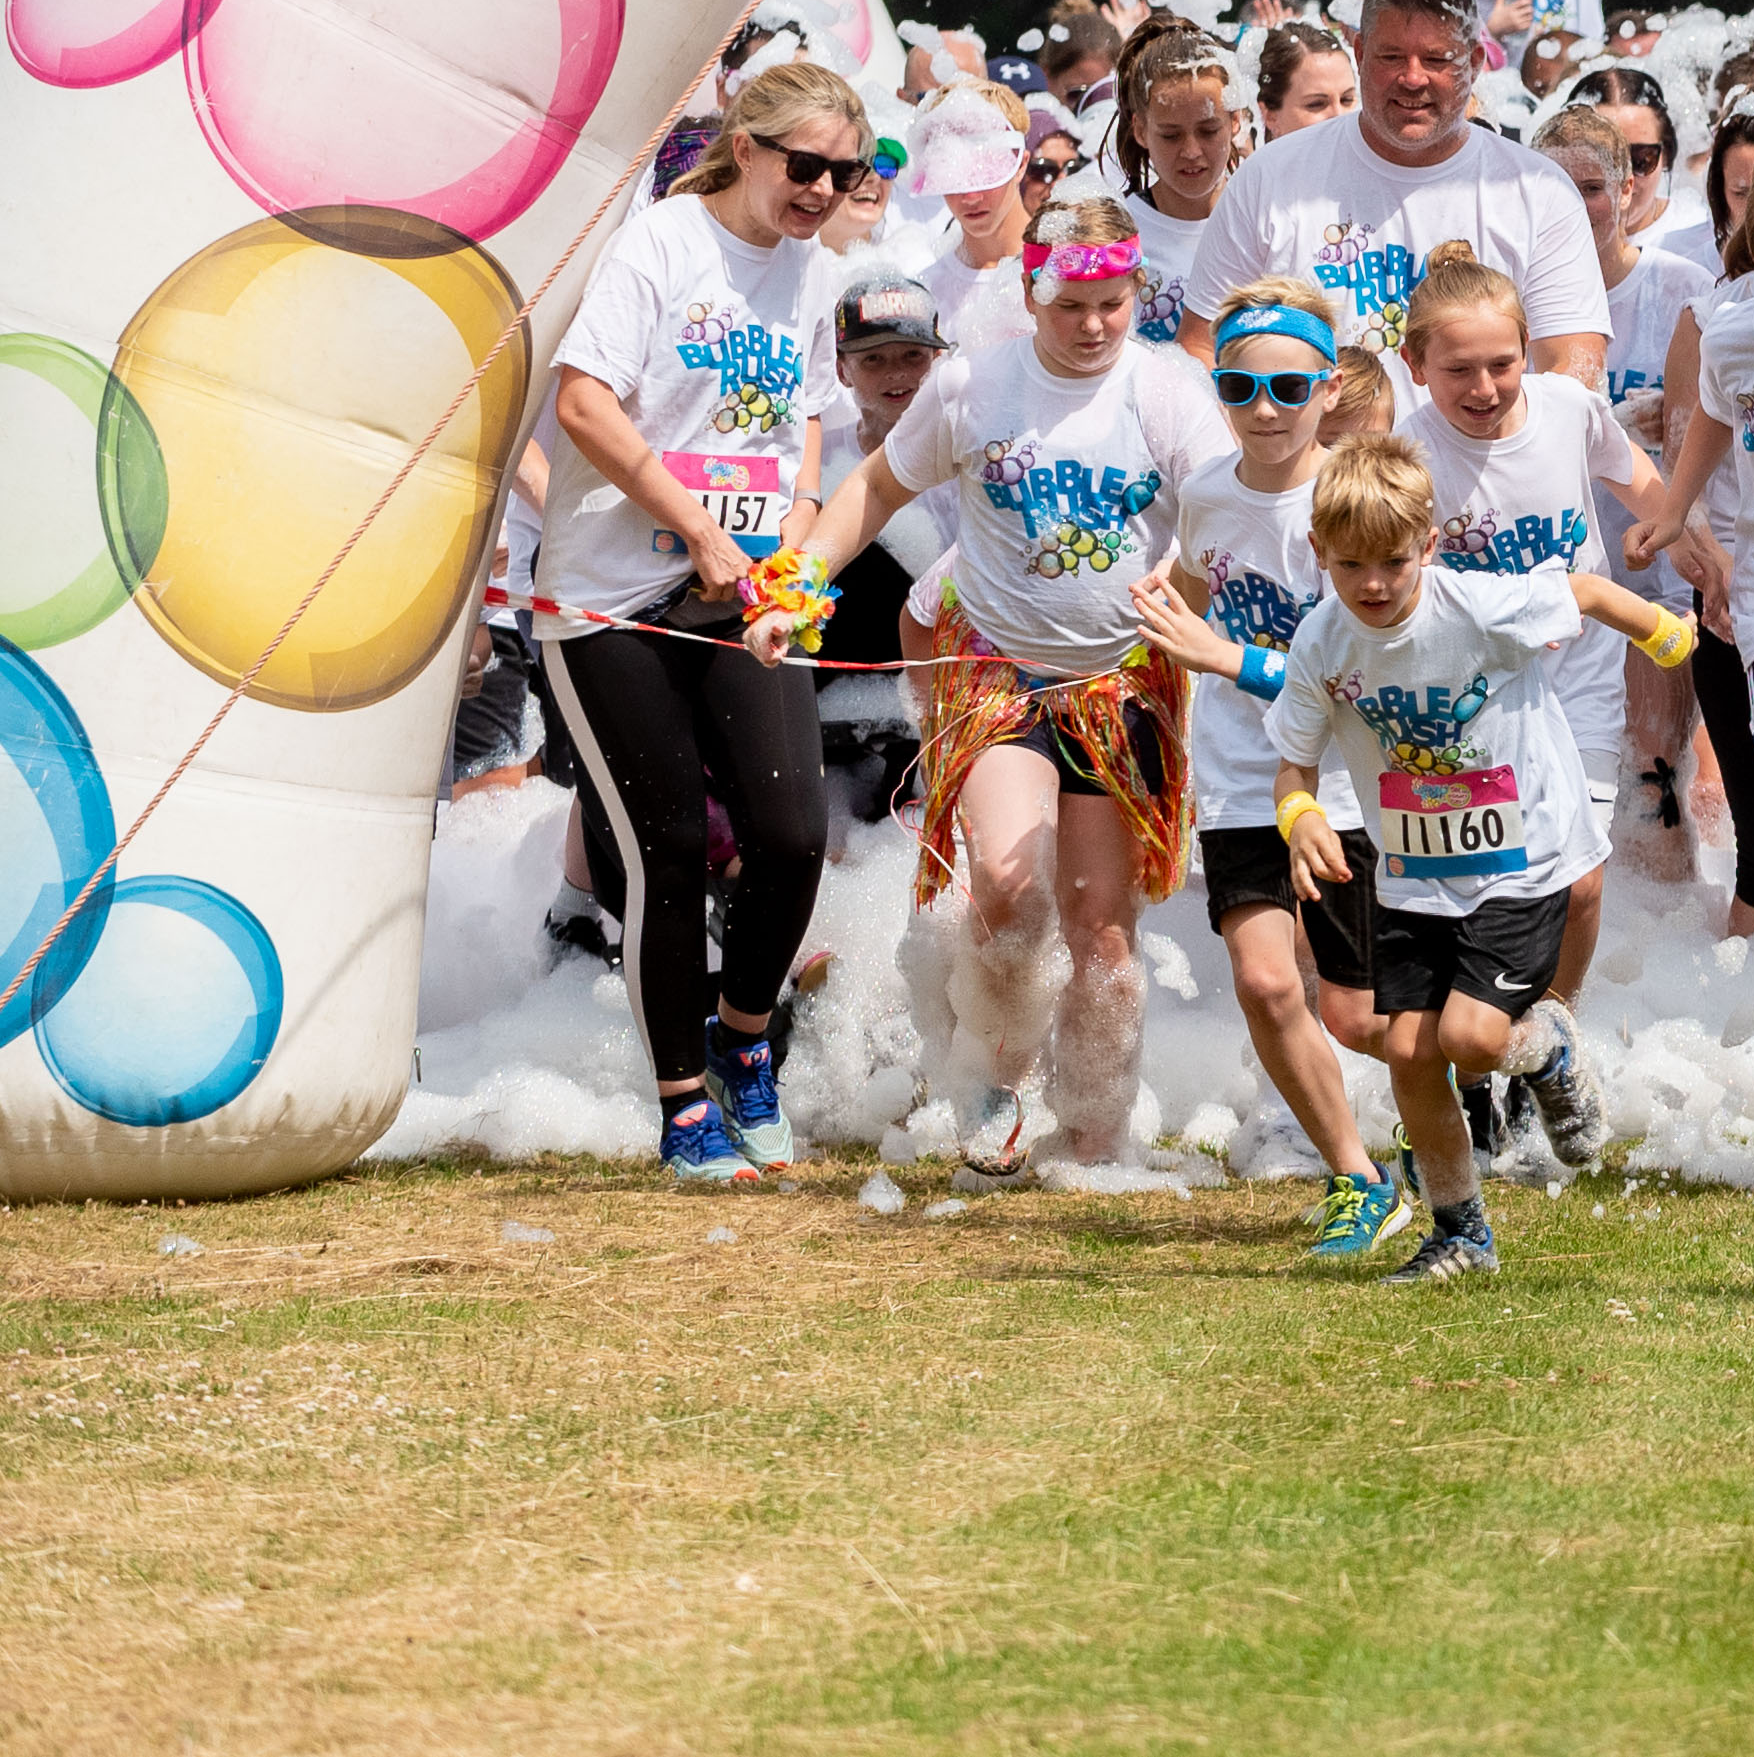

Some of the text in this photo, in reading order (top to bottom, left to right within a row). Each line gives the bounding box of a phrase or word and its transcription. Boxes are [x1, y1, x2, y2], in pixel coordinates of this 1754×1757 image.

[1313, 244, 1428, 291] BUBBL
[676, 324, 796, 369] BUBBLE
[720, 355, 798, 399] RUSH
[982, 459, 1127, 510] BUBBLE
[1439, 508, 1575, 573] BUBBLE
[1402, 808, 1504, 854] 11160
